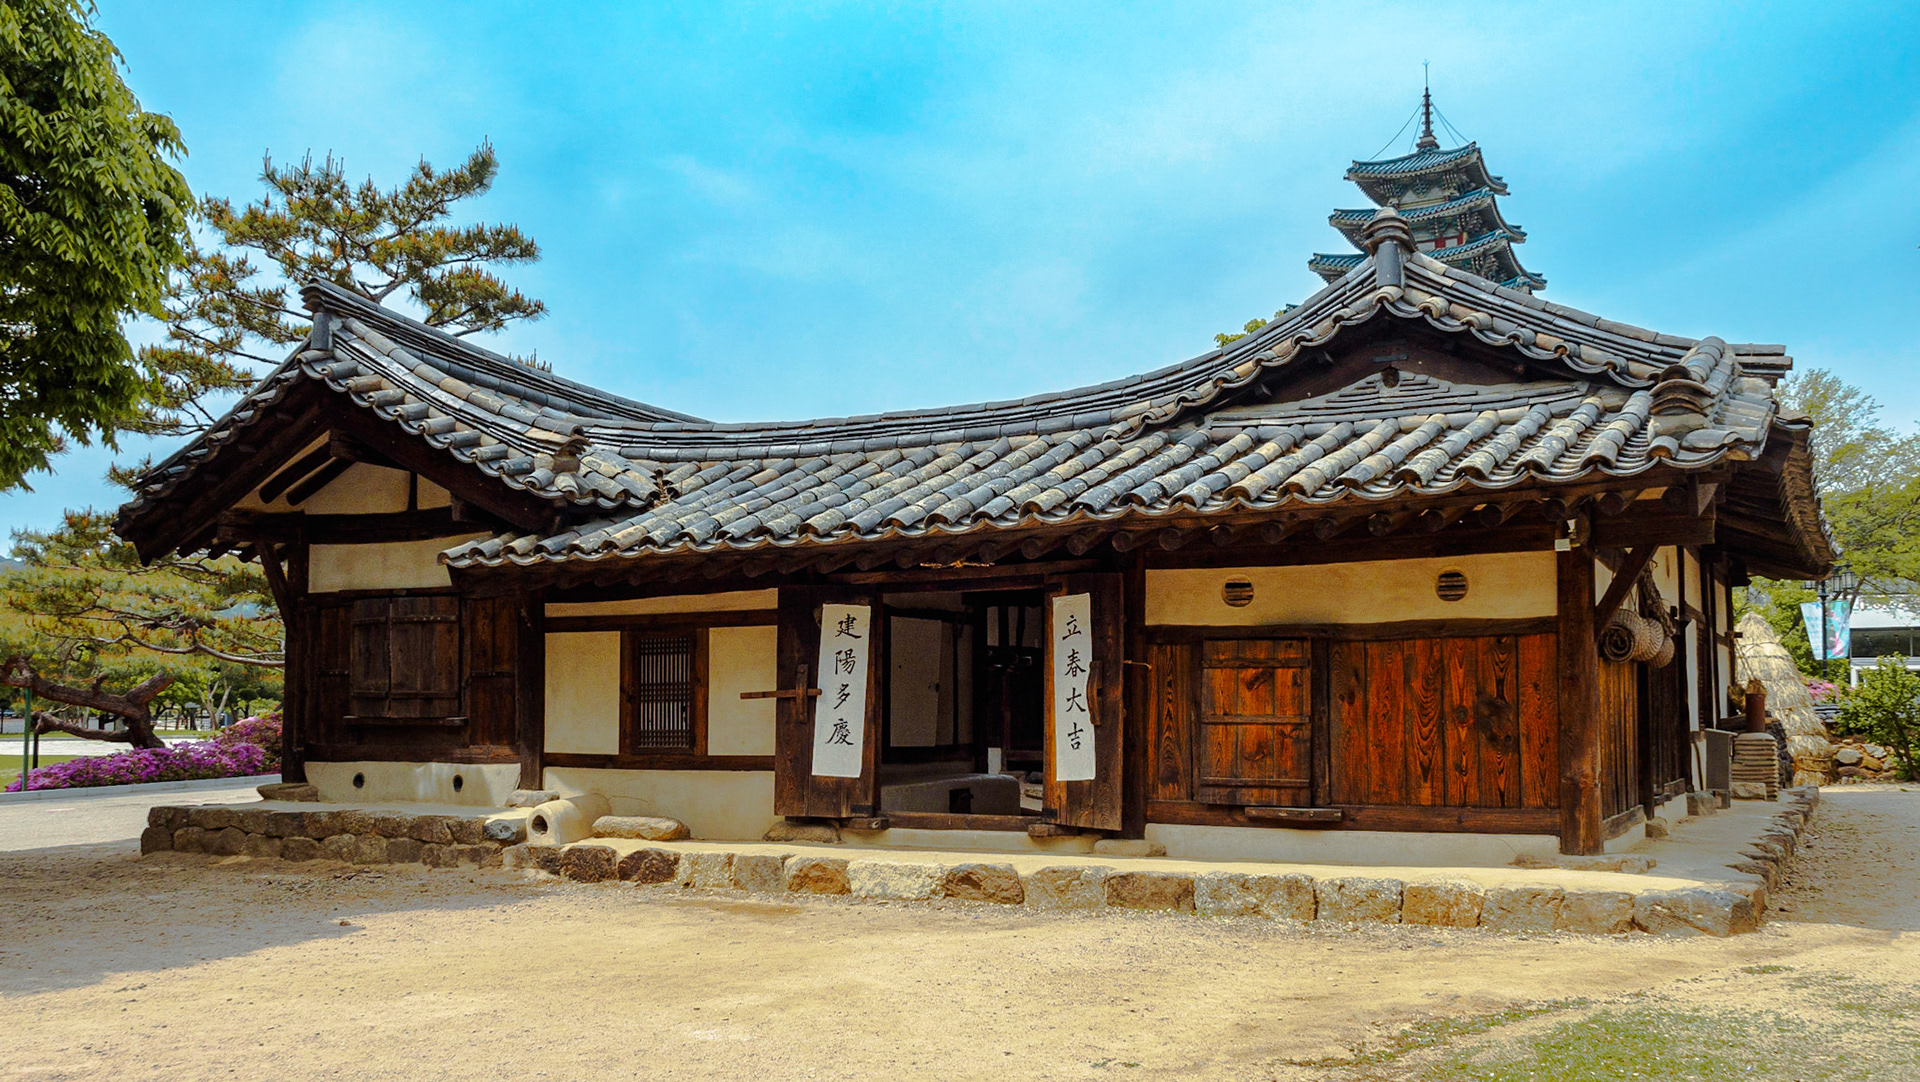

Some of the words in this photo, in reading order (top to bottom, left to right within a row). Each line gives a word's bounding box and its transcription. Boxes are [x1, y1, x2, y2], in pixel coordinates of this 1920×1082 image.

[825, 614, 862, 745] 建陽多慶
[1062, 615, 1087, 750] 立春大吉
